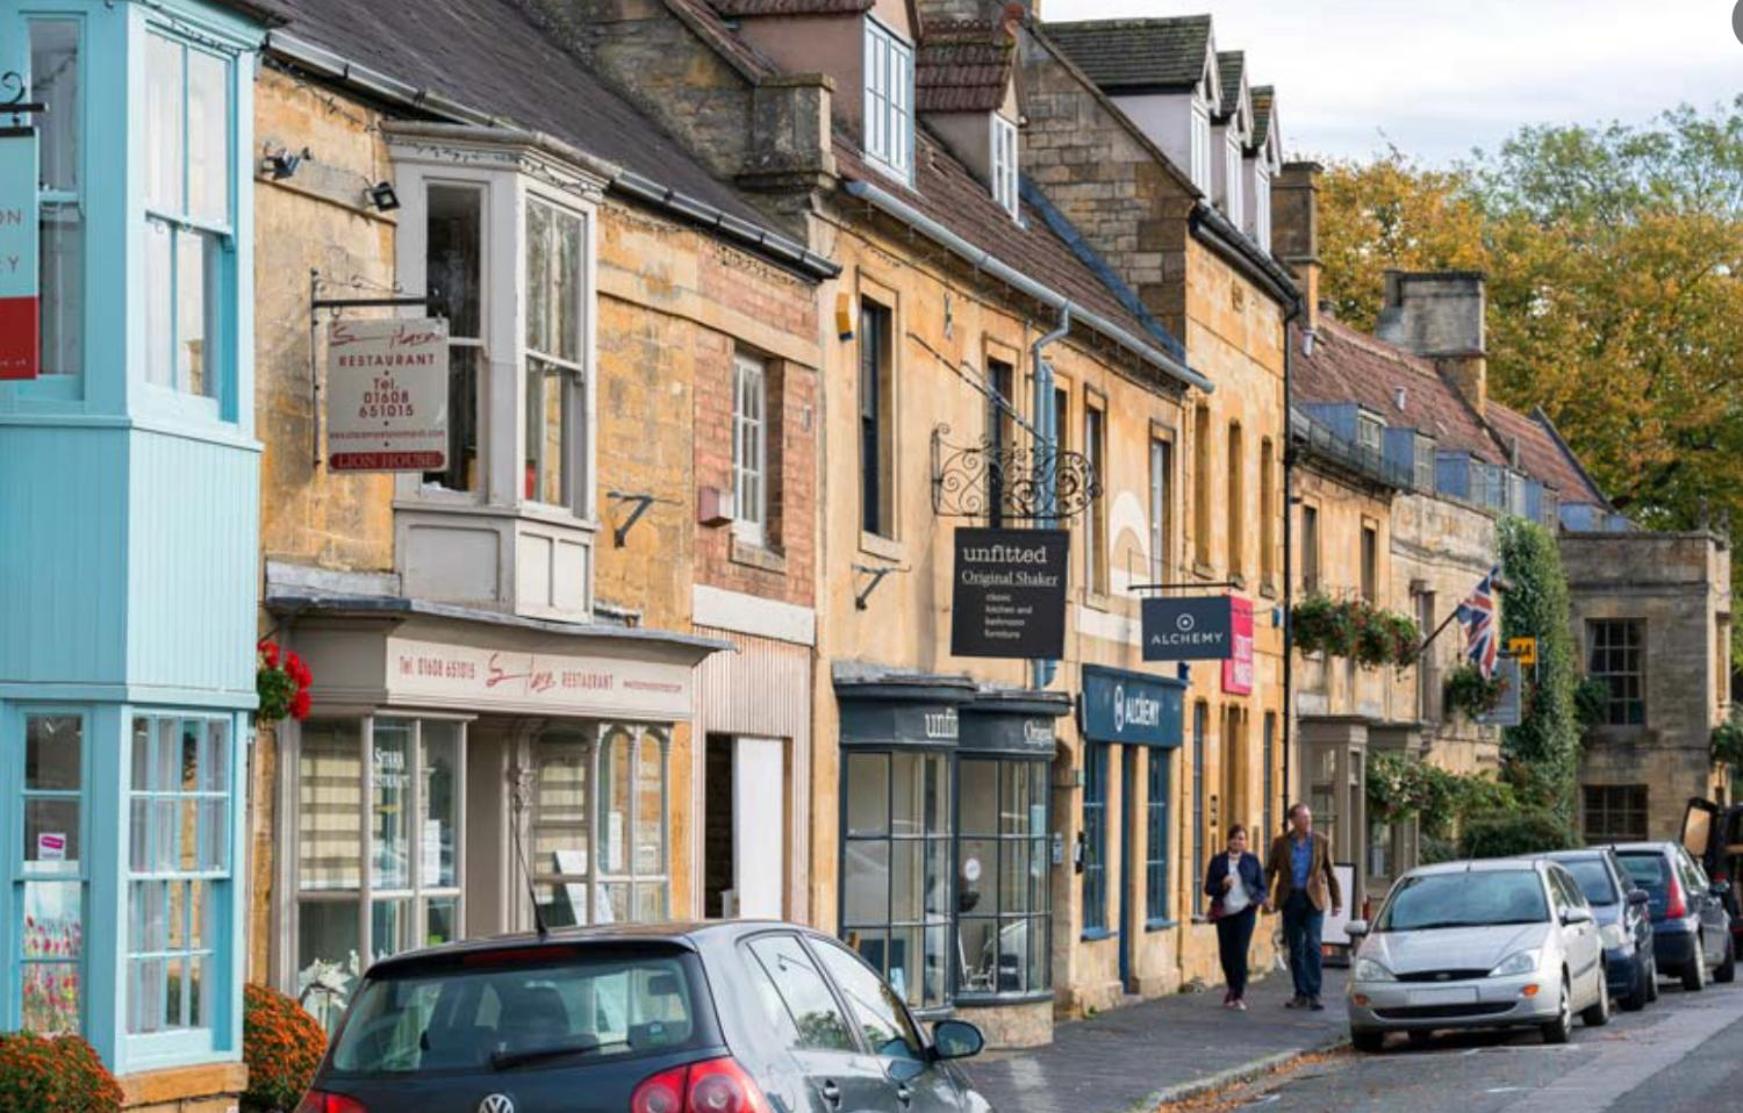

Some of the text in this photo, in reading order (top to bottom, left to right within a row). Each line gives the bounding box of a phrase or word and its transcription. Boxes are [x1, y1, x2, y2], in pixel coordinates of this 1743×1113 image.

[338, 354, 434, 367] RESTAURANT
[363, 391, 409, 404] 01608
[358, 405, 413, 418] 651015
[963, 545, 1047, 563] unfitted
[961, 571, 1058, 587] Original Shaker
[1017, 605, 1032, 614] and
[1151, 632, 1223, 645] ALCHEMY
[562, 672, 613, 690] RESTAURANT
